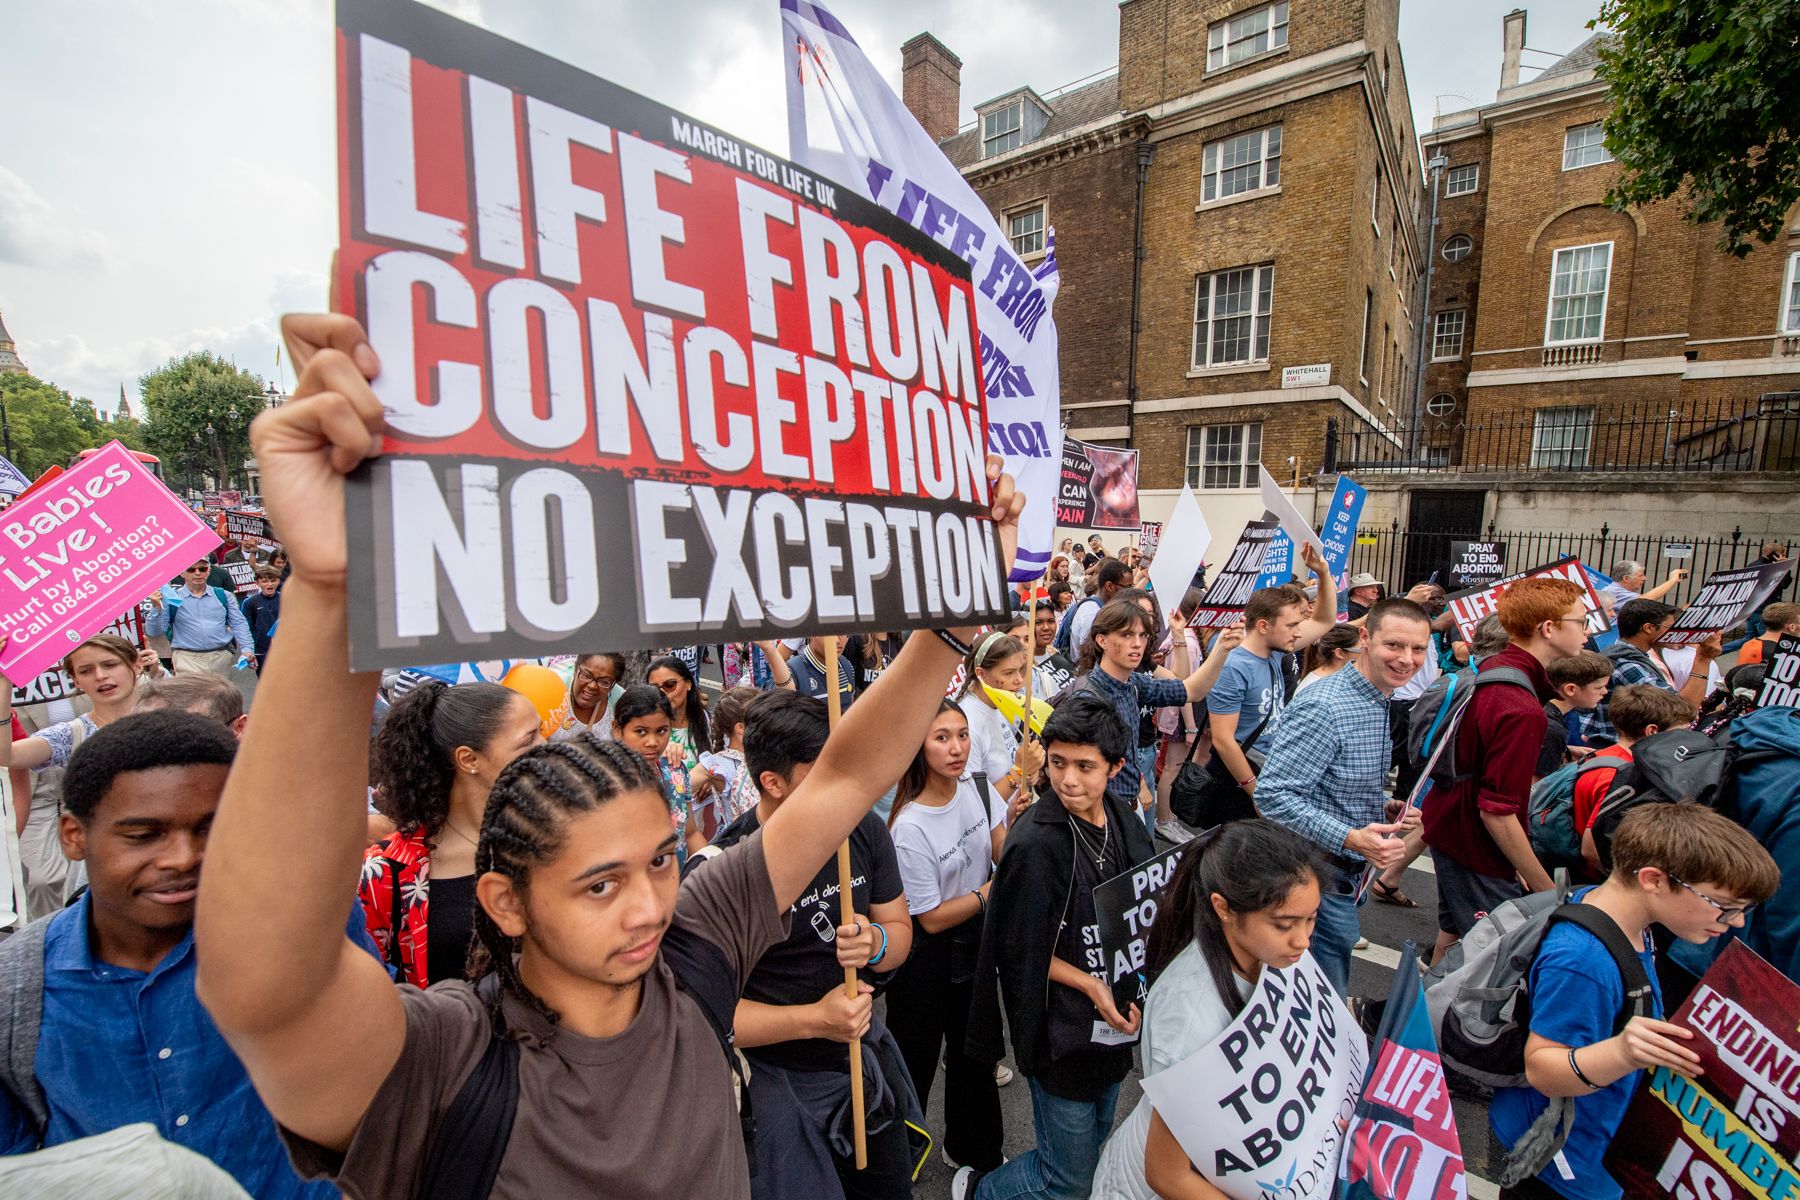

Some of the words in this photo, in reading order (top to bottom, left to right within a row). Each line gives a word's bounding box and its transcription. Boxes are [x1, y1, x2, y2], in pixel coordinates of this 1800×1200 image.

[671, 116, 742, 167] MARCH
[745, 148, 779, 183] FOR
[781, 164, 814, 200] LIFE
[815, 179, 838, 210] UK
[358, 32, 706, 318] LIFE
[735, 177, 979, 406] FROM
[366, 251, 988, 507] CONCEPTION
[1286, 366, 1328, 376] WHITEHALL
[1062, 457, 1074, 468] HEN
[1078, 462, 1092, 472] AM
[2, 463, 131, 550] Babies
[1062, 484, 1088, 499] CAN
[1270, 539, 1289, 548] MAN
[1333, 521, 1348, 535] CALM
[390, 459, 601, 638] NO
[633, 480, 1002, 625] EXCEPTION
[1266, 548, 1287, 557] GHTS
[1324, 538, 1346, 554] CHOOSE
[1326, 551, 1337, 563] LIFE
[1462, 553, 1478, 563] TO
[1479, 553, 1499, 563] END
[1468, 543, 1495, 553] PRAY
[0, 596, 44, 632] Hurt
[41, 578, 70, 600] by
[72, 515, 159, 582] Abortion?
[1451, 563, 1504, 574] ABORTION
[12, 611, 53, 643] Call
[52, 580, 98, 615] 0845
[97, 557, 132, 584] 603
[131, 527, 174, 560] 8501
[1204, 573, 1240, 604] TOO
[1693, 584, 1717, 606] 10
[1711, 579, 1759, 606] MILLION
[1188, 610, 1217, 627] END
[1449, 588, 1498, 625] LIFE
[1673, 606, 1710, 628] TOO
[1699, 602, 1747, 628] MANY
[1658, 632, 1688, 643] END
[1773, 652, 1800, 683] 10
[800, 888, 819, 908] end
[822, 875, 867, 898] aboion
[1122, 899, 1158, 937] TO
[1219, 965, 1288, 1075] PRAY
[1218, 1062, 1282, 1125] TO
[1279, 967, 1313, 1068] END
[1215, 969, 1337, 1177] ABORTION
[1373, 1045, 1444, 1122] LIFE
[1734, 1084, 1787, 1143] IS
